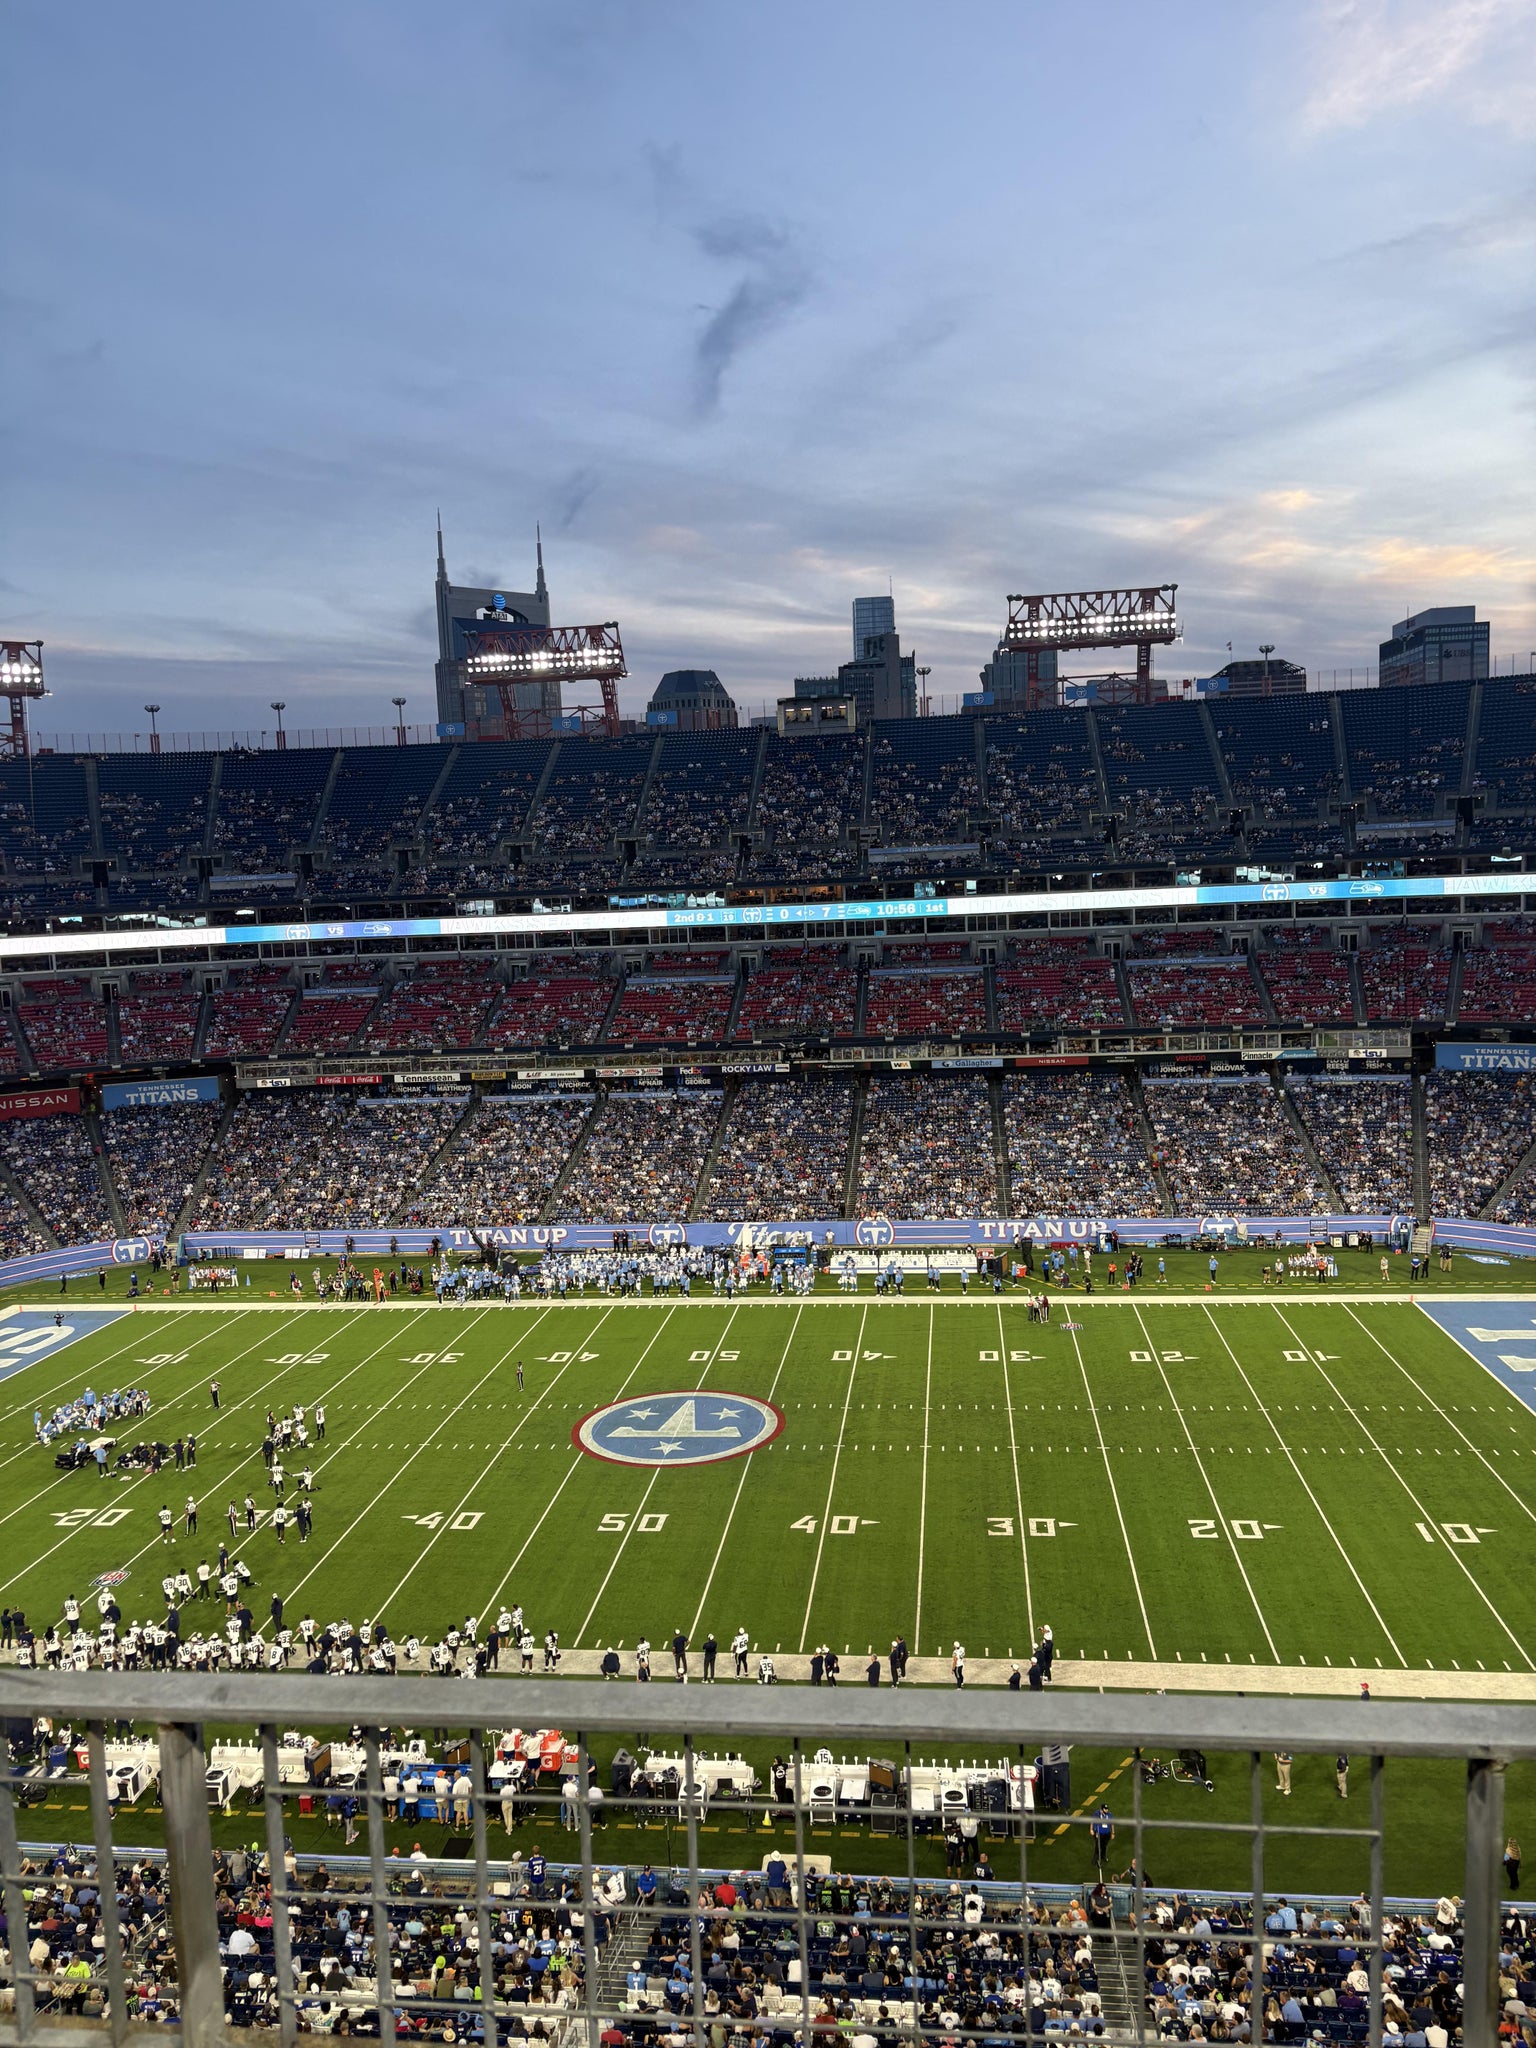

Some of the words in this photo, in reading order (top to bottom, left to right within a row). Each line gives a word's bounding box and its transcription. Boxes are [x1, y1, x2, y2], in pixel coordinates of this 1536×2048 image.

[490, 611, 508, 621] AT&T
[1453, 649, 1471, 657] UBS
[822, 907, 831, 918] 7
[877, 904, 916, 915] 10:56
[925, 903, 944, 912] 1st
[674, 913, 695, 923] 2nd
[780, 909, 789, 919] 0
[1242, 1051, 1273, 1059] Pinnacle
[1362, 1050, 1383, 1058] tsu
[955, 1059, 993, 1067] Gallagher
[1460, 1055, 1536, 1069] TITANS
[679, 1066, 702, 1074] FedEx
[1210, 1064, 1246, 1072] HOLOVAK
[137, 1083, 185, 1092] TENNESSEE
[0, 1094, 68, 1109] NISSAN
[125, 1089, 199, 1105] TITANS
[728, 1222, 813, 1246] Titans
[979, 1222, 1067, 1238] TITAN
[1069, 1221, 1108, 1237] UP
[450, 1227, 530, 1245] TITAN
[532, 1227, 568, 1244] UP
[688, 1351, 741, 1362] 50
[831, 1350, 883, 1361] 40
[979, 1350, 1032, 1362] 30
[1130, 1350, 1185, 1362] 20
[54, 1508, 134, 1526] 20
[415, 1511, 486, 1530] 40
[596, 1513, 670, 1532] 50
[789, 1515, 860, 1534] 40
[986, 1517, 1057, 1537] 30
[1187, 1519, 1265, 1539] 20
[1414, 1522, 1482, 1544] 10
[164, 1581, 173, 1590] 39
[177, 1578, 188, 1587] 30
[228, 1583, 236, 1591] 10
[209, 1644, 220, 1653] 48
[409, 1641, 418, 1650] 21
[523, 1641, 534, 1649] 27
[181, 1647, 190, 1656] 16
[61, 1661, 72, 1670] 97
[761, 1662, 772, 1672] 35
[540, 1755, 553, 1769] G
[820, 1753, 829, 1763] 15
[533, 1865, 543, 1876] 21
[522, 1914, 533, 1925] 90
[352, 1954, 360, 1963] 11
[256, 1990, 268, 2003] 14
